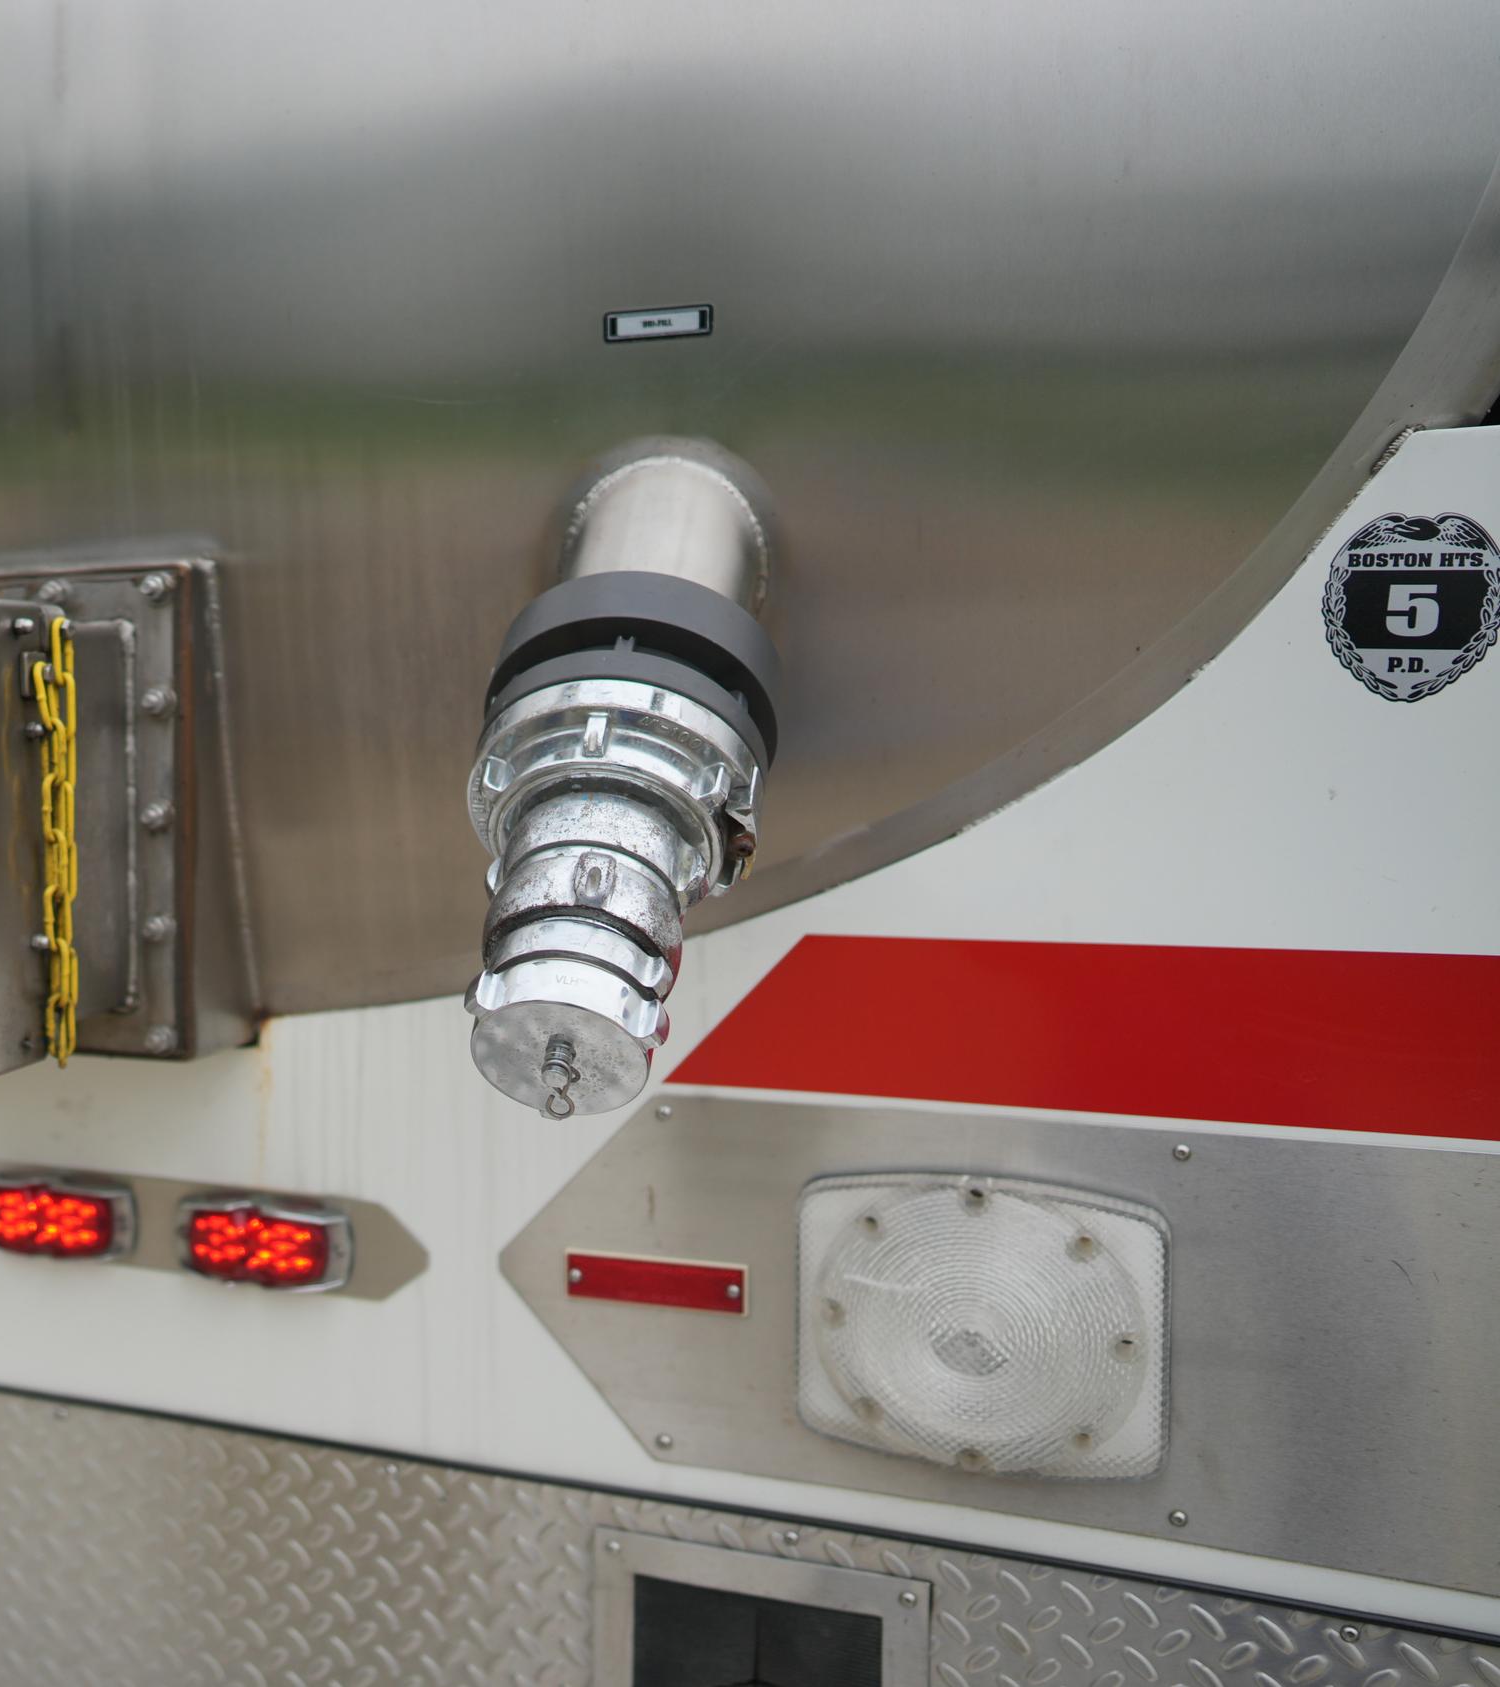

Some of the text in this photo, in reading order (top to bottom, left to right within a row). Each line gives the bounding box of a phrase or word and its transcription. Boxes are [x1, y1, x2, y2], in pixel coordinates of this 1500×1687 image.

[1348, 552, 1489, 567] BOSTON HTS.
[1385, 584, 1440, 637] 5
[1387, 656, 1430, 673] P.D.
